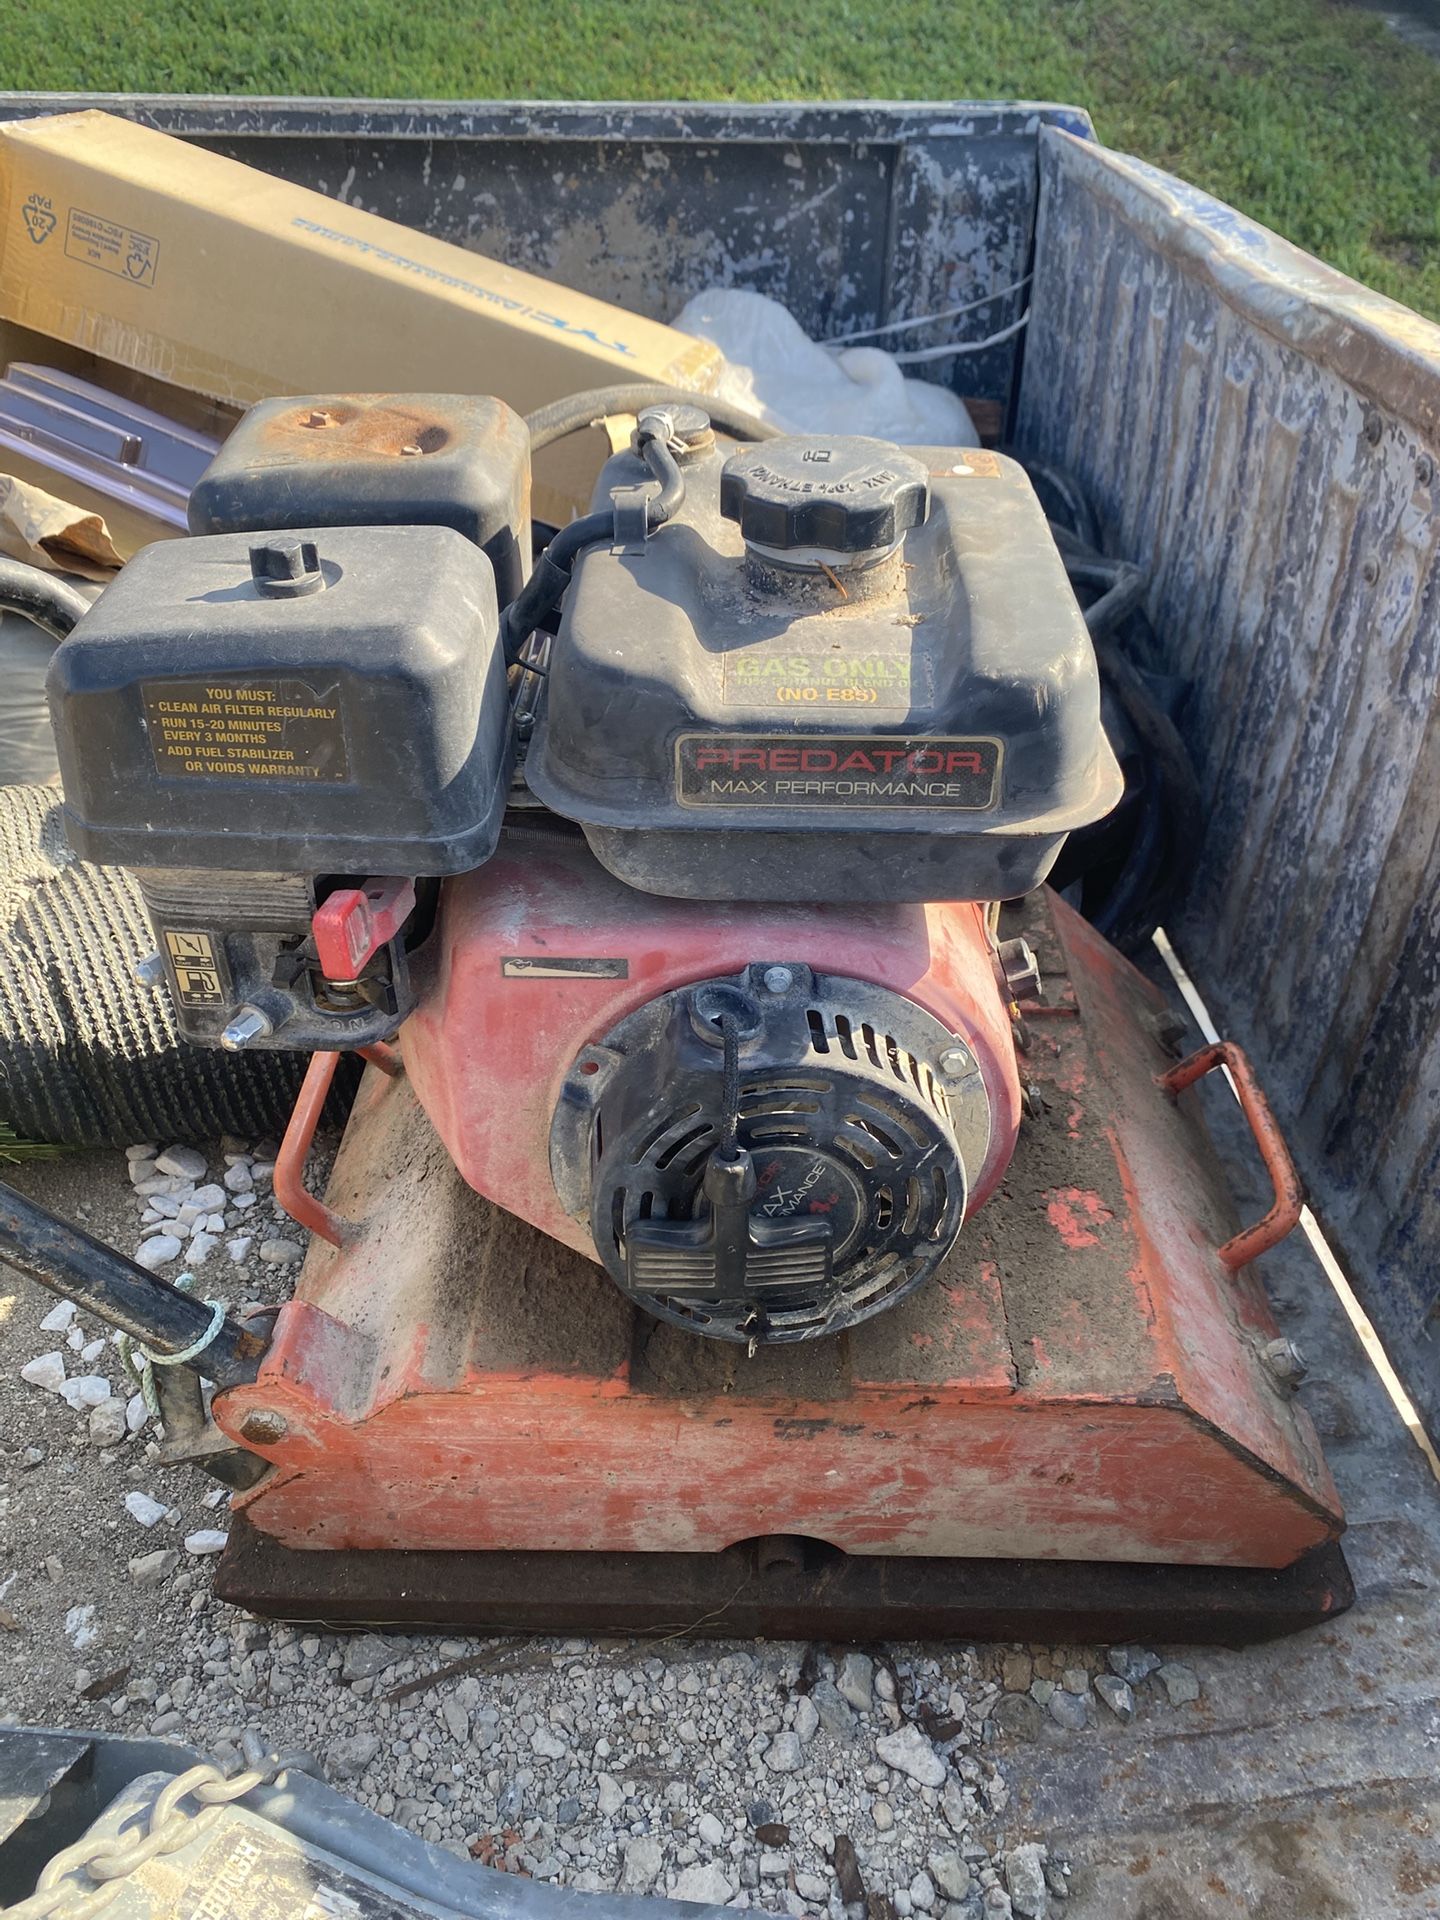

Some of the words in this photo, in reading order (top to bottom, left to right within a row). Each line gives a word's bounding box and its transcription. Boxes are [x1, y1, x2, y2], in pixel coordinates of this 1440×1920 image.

[28, 193, 52, 209] PAP
[32, 215, 46, 229] 20
[749, 464, 813, 493] ETHANOL
[736, 656, 811, 677] GAS
[823, 658, 914, 679] ONLY
[206, 688, 233, 700] YOU
[236, 690, 276, 702] MUST:
[776, 686, 819, 702] (NO
[826, 687, 878, 703] E85)
[158, 701, 198, 713] CLEAN
[201, 703, 222, 714] AIR
[225, 704, 265, 716] FILTER
[267, 706, 336, 719] REGULARLY
[161, 717, 187, 728] RUN
[190, 718, 225, 730] 15-20
[228, 720, 282, 732] MINUTES
[164, 730, 201, 741] EVERY
[205, 732, 213, 742] 3
[215, 733, 267, 744] MONTHS
[167, 746, 192, 756] ADD
[195, 747, 225, 757] FUEL
[227, 748, 295, 760] STABILIZER
[696, 748, 983, 774] PREDATOR
[185, 761, 203, 771] OR
[206, 762, 245, 774] VOIDS
[249, 763, 321, 777] WARRANTY
[711, 779, 769, 794] MAX
[775, 780, 961, 797] PERFORMANCE
[756, 1185, 793, 1217] AX
